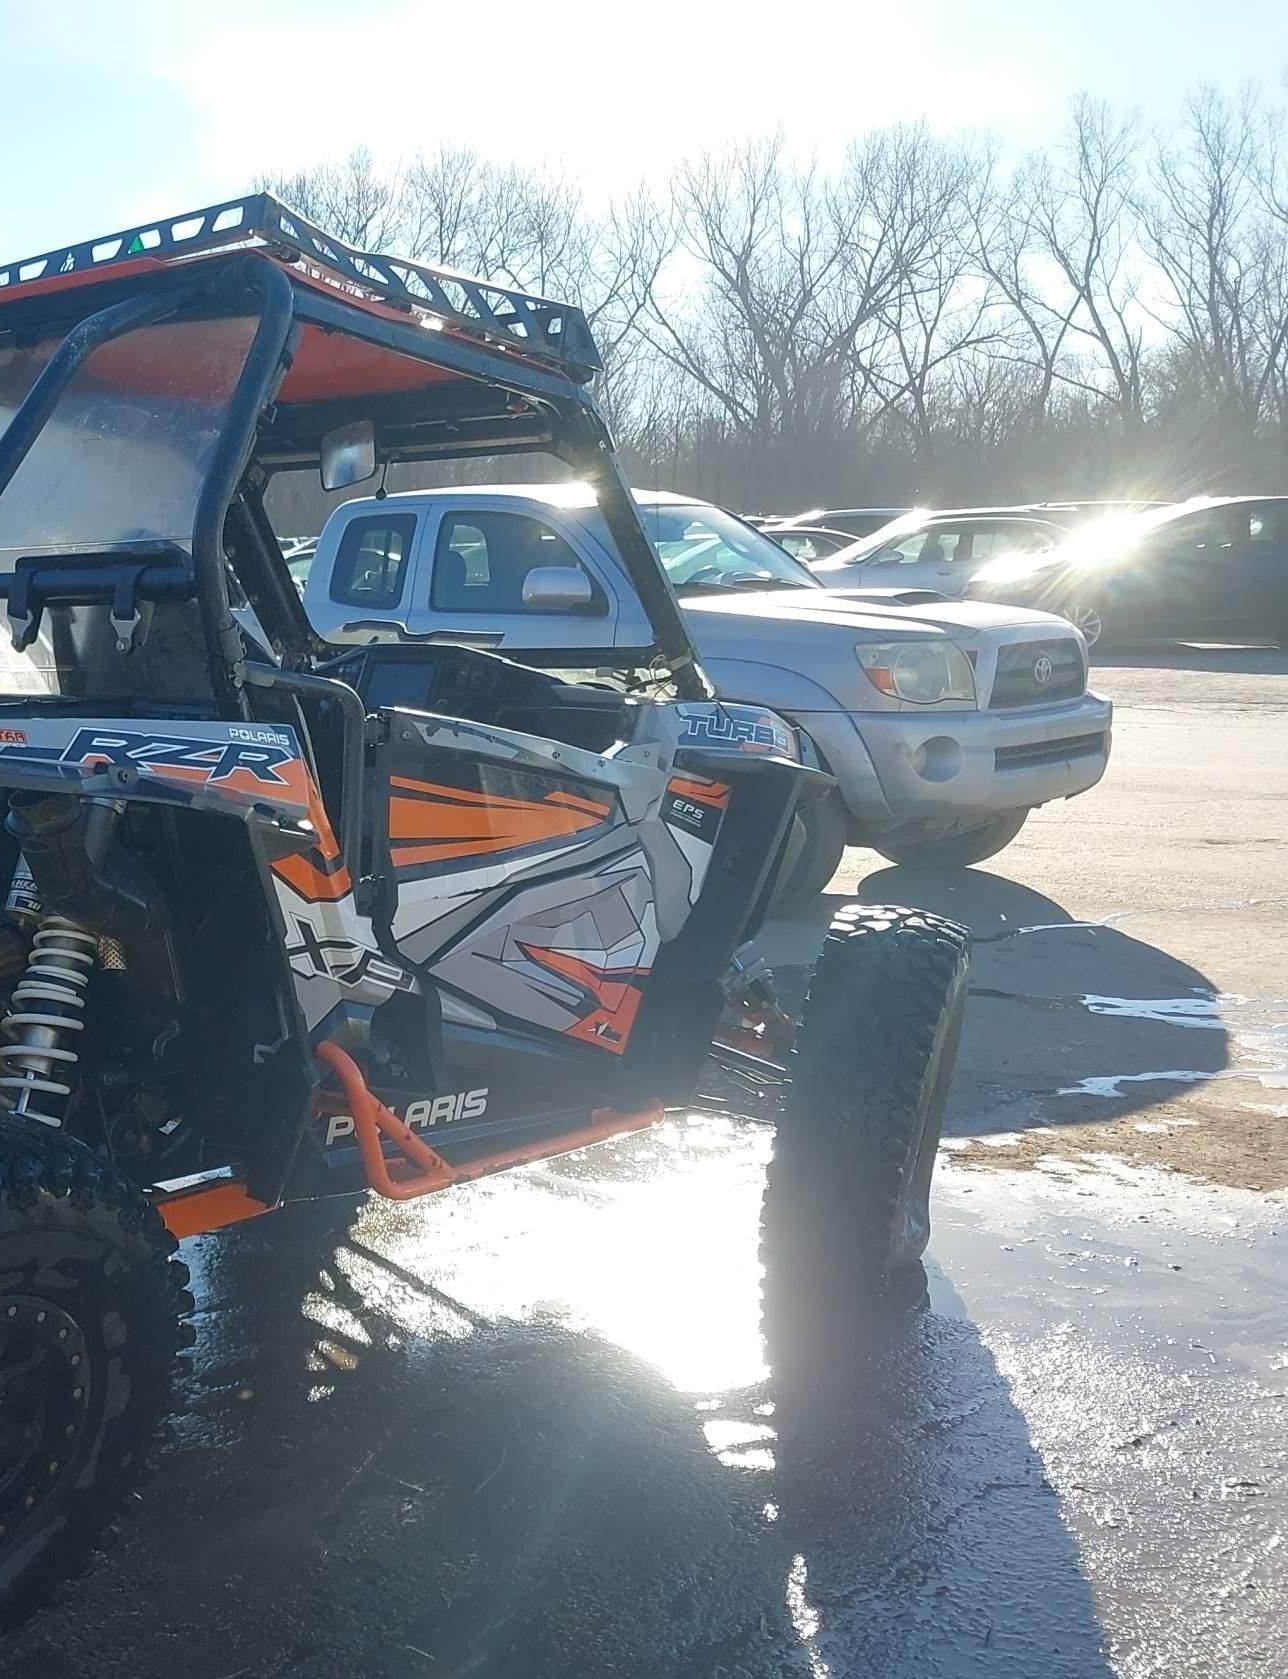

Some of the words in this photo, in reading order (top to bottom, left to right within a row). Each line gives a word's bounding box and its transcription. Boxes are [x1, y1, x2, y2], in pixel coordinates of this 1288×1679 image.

[228, 727, 290, 746] POLARIS
[679, 712, 791, 754] TURBO
[58, 726, 295, 786] RZR
[672, 799, 705, 819] EPS
[325, 1087, 489, 1146] PARIS
